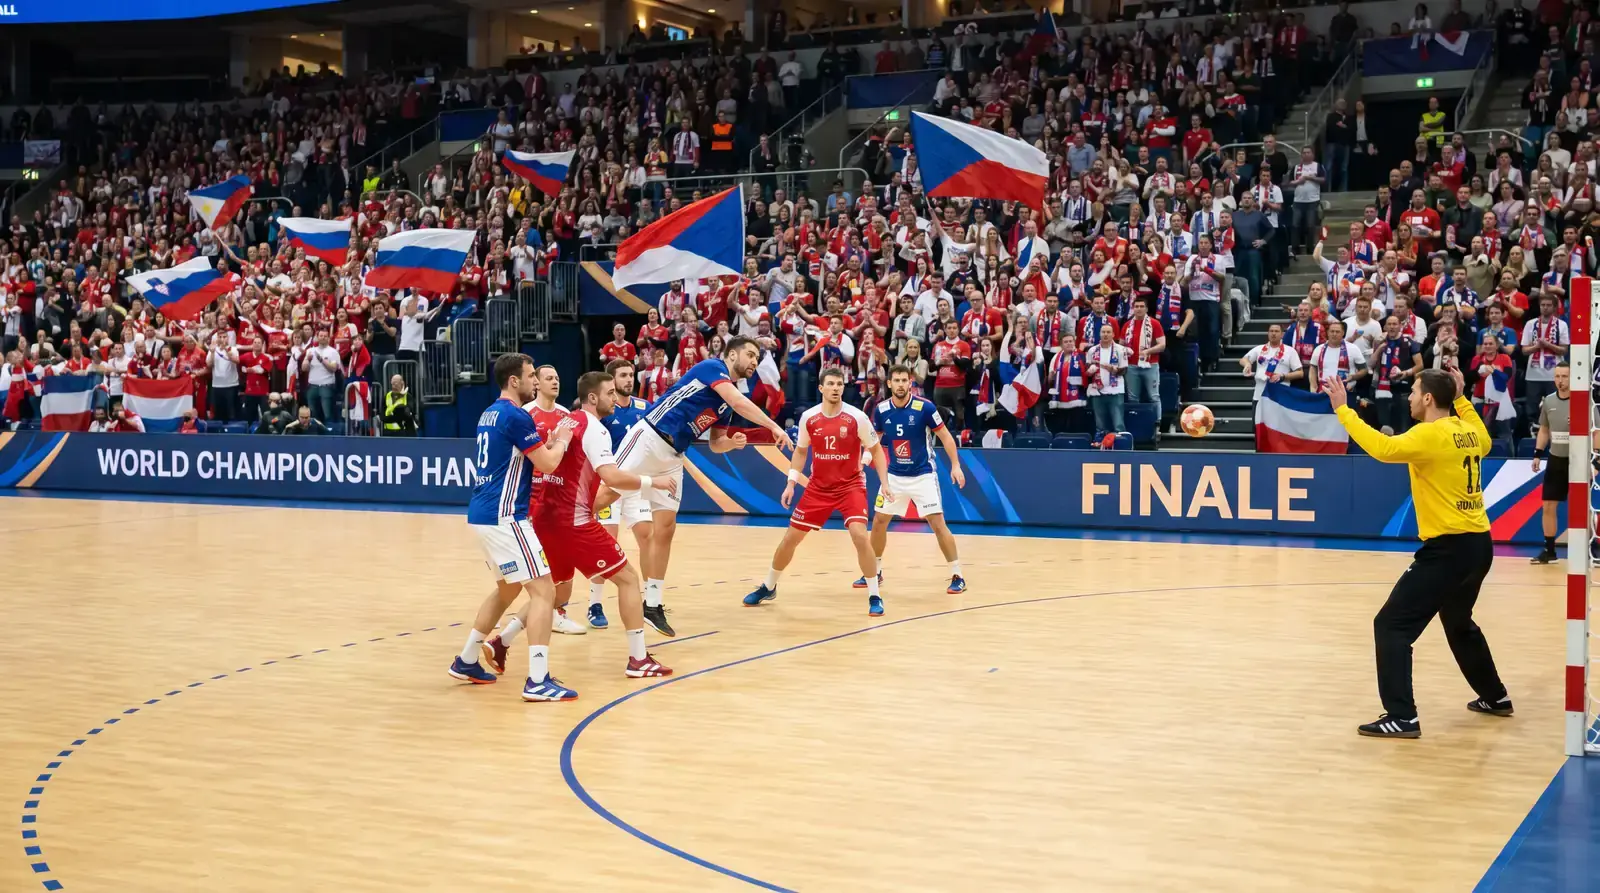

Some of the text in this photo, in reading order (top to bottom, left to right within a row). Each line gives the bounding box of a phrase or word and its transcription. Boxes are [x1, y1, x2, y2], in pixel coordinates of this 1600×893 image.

[824, 435, 837, 450] 12
[896, 423, 904, 437] 5
[97, 448, 190, 478] WORLD
[196, 450, 414, 485] CHAMPIONSHIP
[476, 431, 490, 469] 13
[1081, 462, 1316, 522] FINALE
